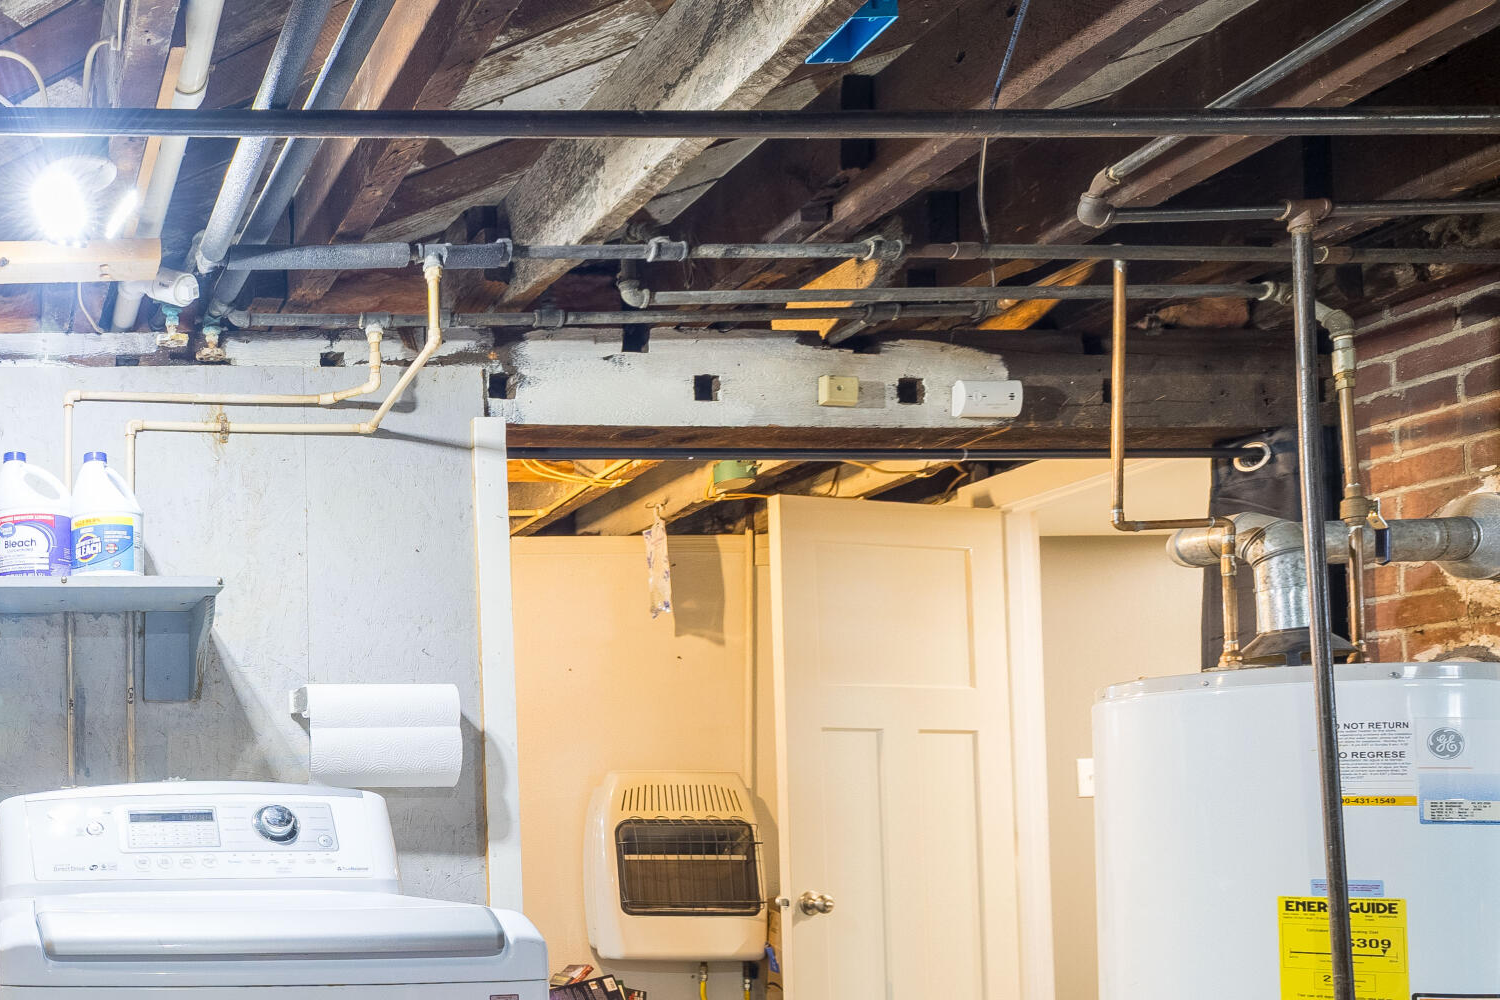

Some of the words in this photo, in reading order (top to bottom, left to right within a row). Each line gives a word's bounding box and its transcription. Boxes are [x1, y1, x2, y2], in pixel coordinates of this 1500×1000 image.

[4, 538, 37, 550] Bleach
[1343, 722, 1365, 730] NOT
[1367, 721, 1410, 729] RETURN
[1351, 750, 1407, 759] REGRESE
